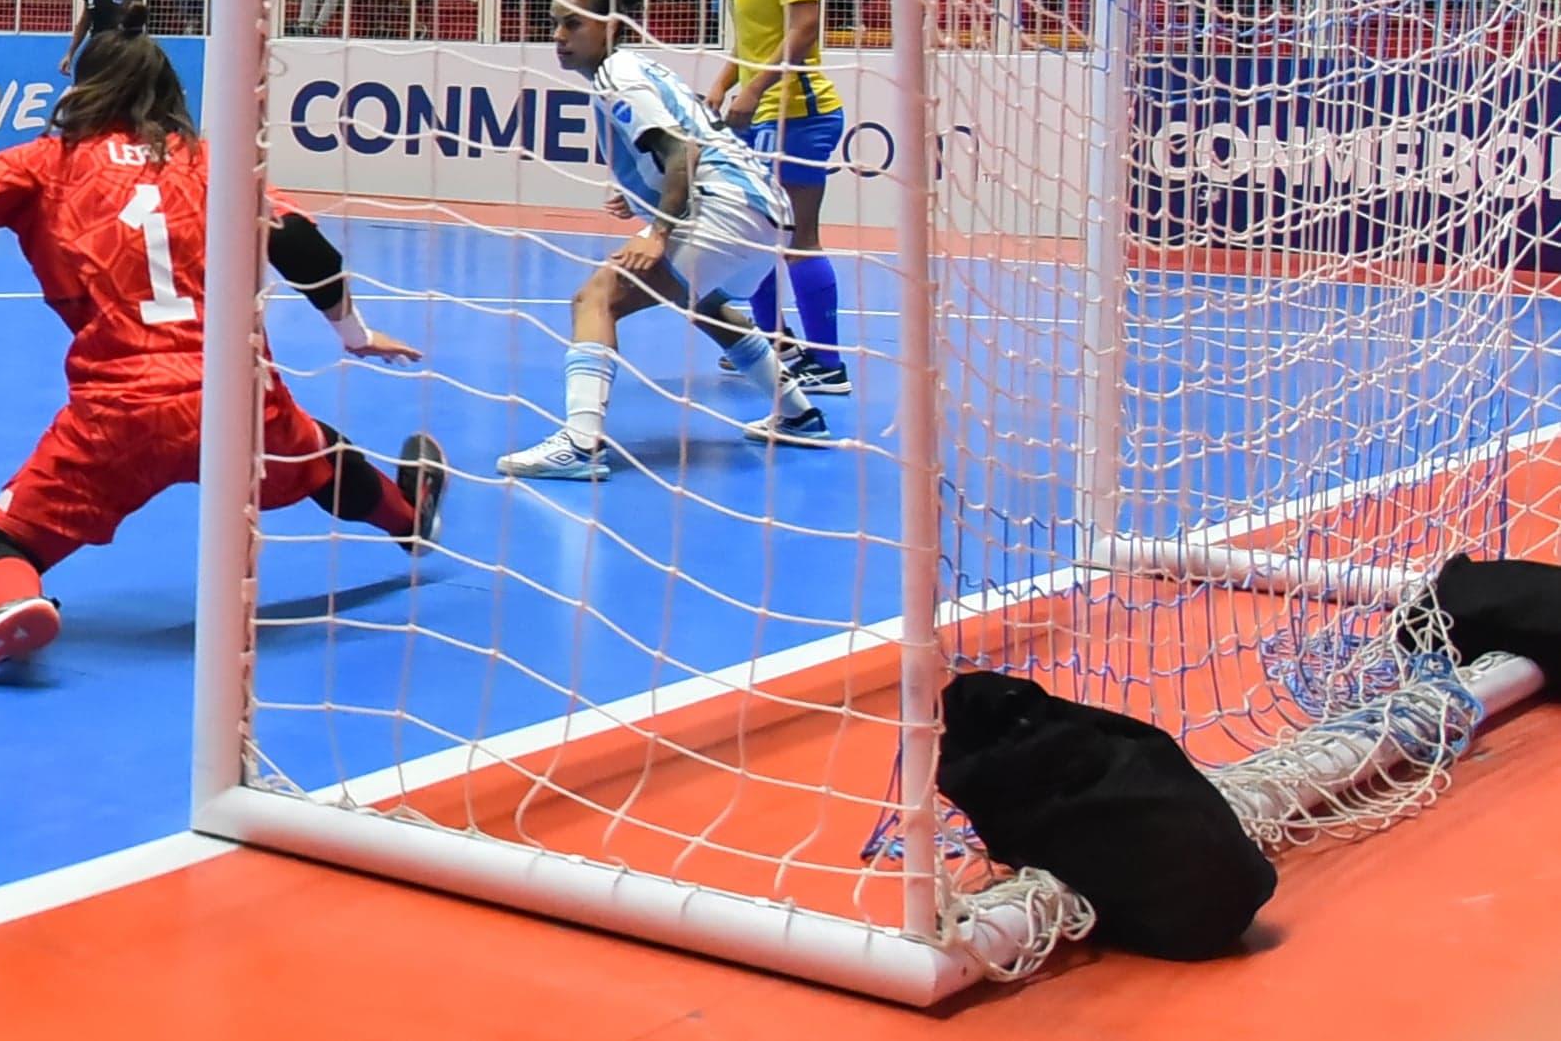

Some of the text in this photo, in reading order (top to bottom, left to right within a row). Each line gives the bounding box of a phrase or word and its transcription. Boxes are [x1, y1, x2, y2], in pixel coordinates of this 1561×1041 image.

[290, 80, 609, 165] CONME
[1152, 121, 1561, 201] CONMEBO
[117, 184, 198, 325] 1
